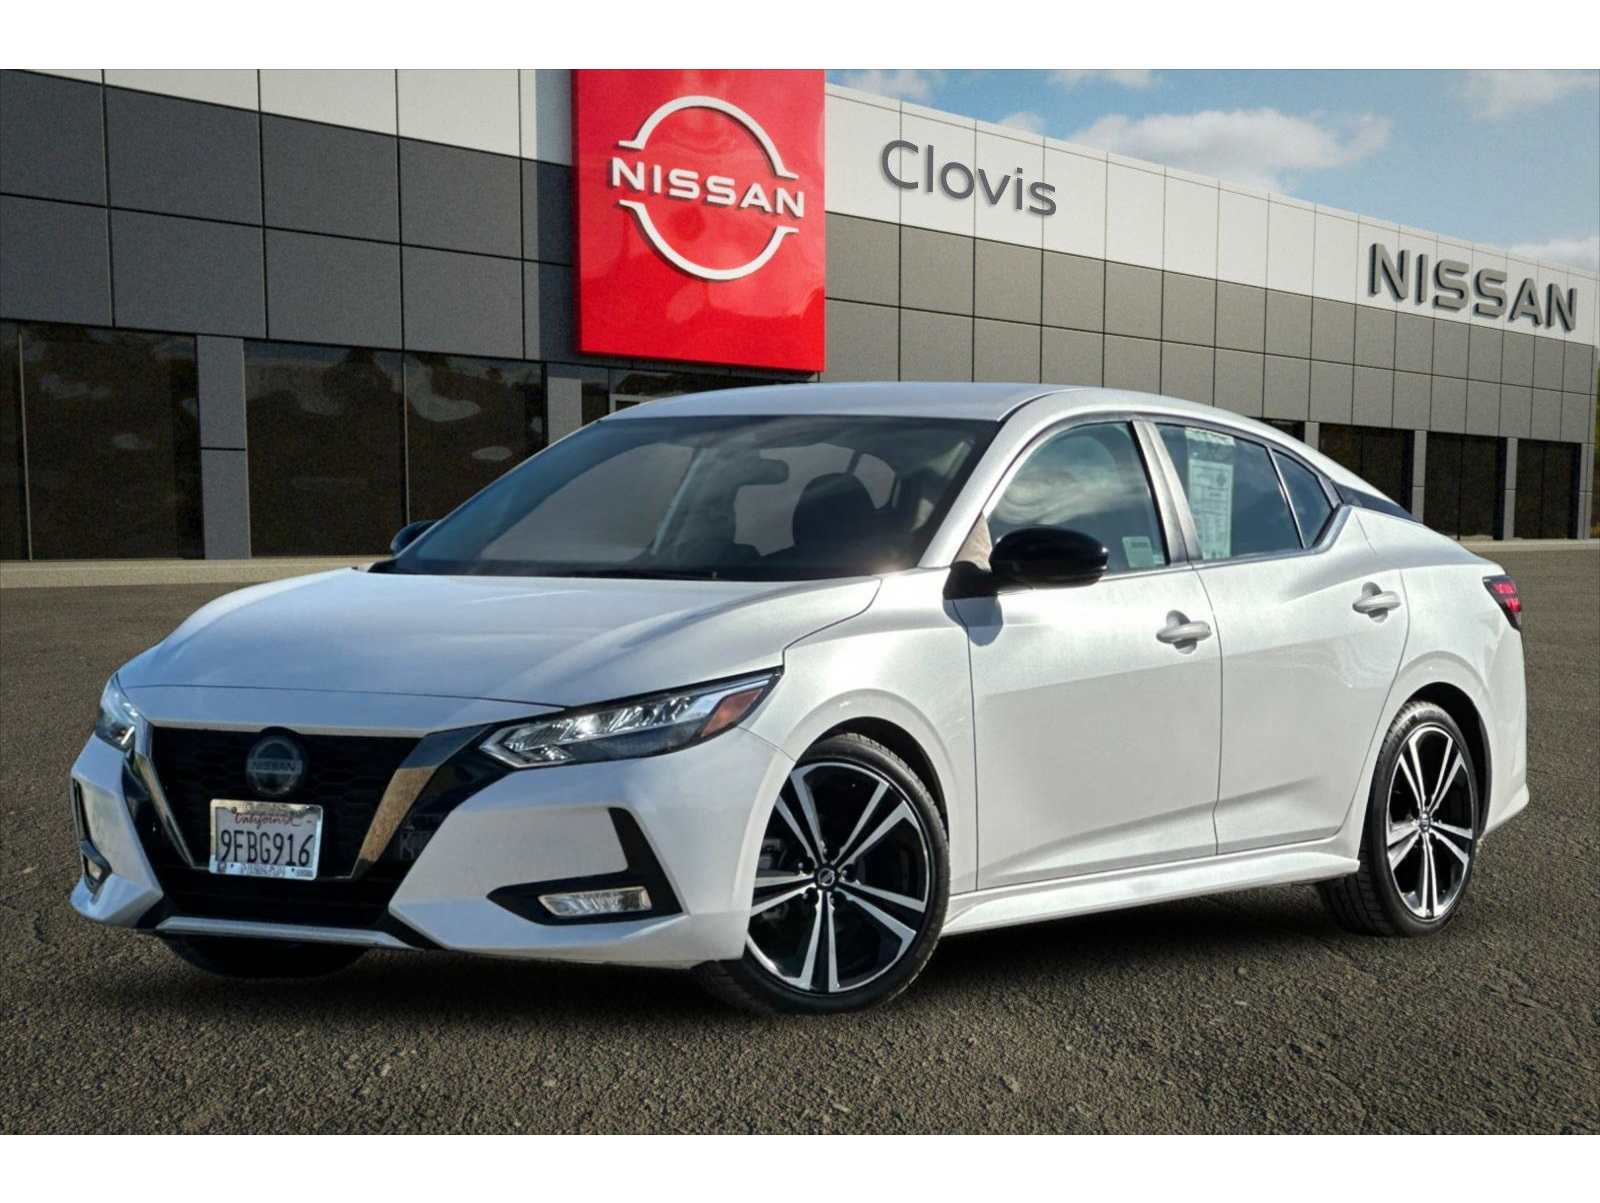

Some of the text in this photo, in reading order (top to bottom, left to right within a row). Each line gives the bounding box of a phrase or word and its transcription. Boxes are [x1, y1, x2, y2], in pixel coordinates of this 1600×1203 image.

[611, 157, 804, 218] NISSAN
[881, 140, 1057, 215] Clovis
[1368, 242, 1578, 331] NISSAN
[220, 829, 314, 867] 9FBG916
